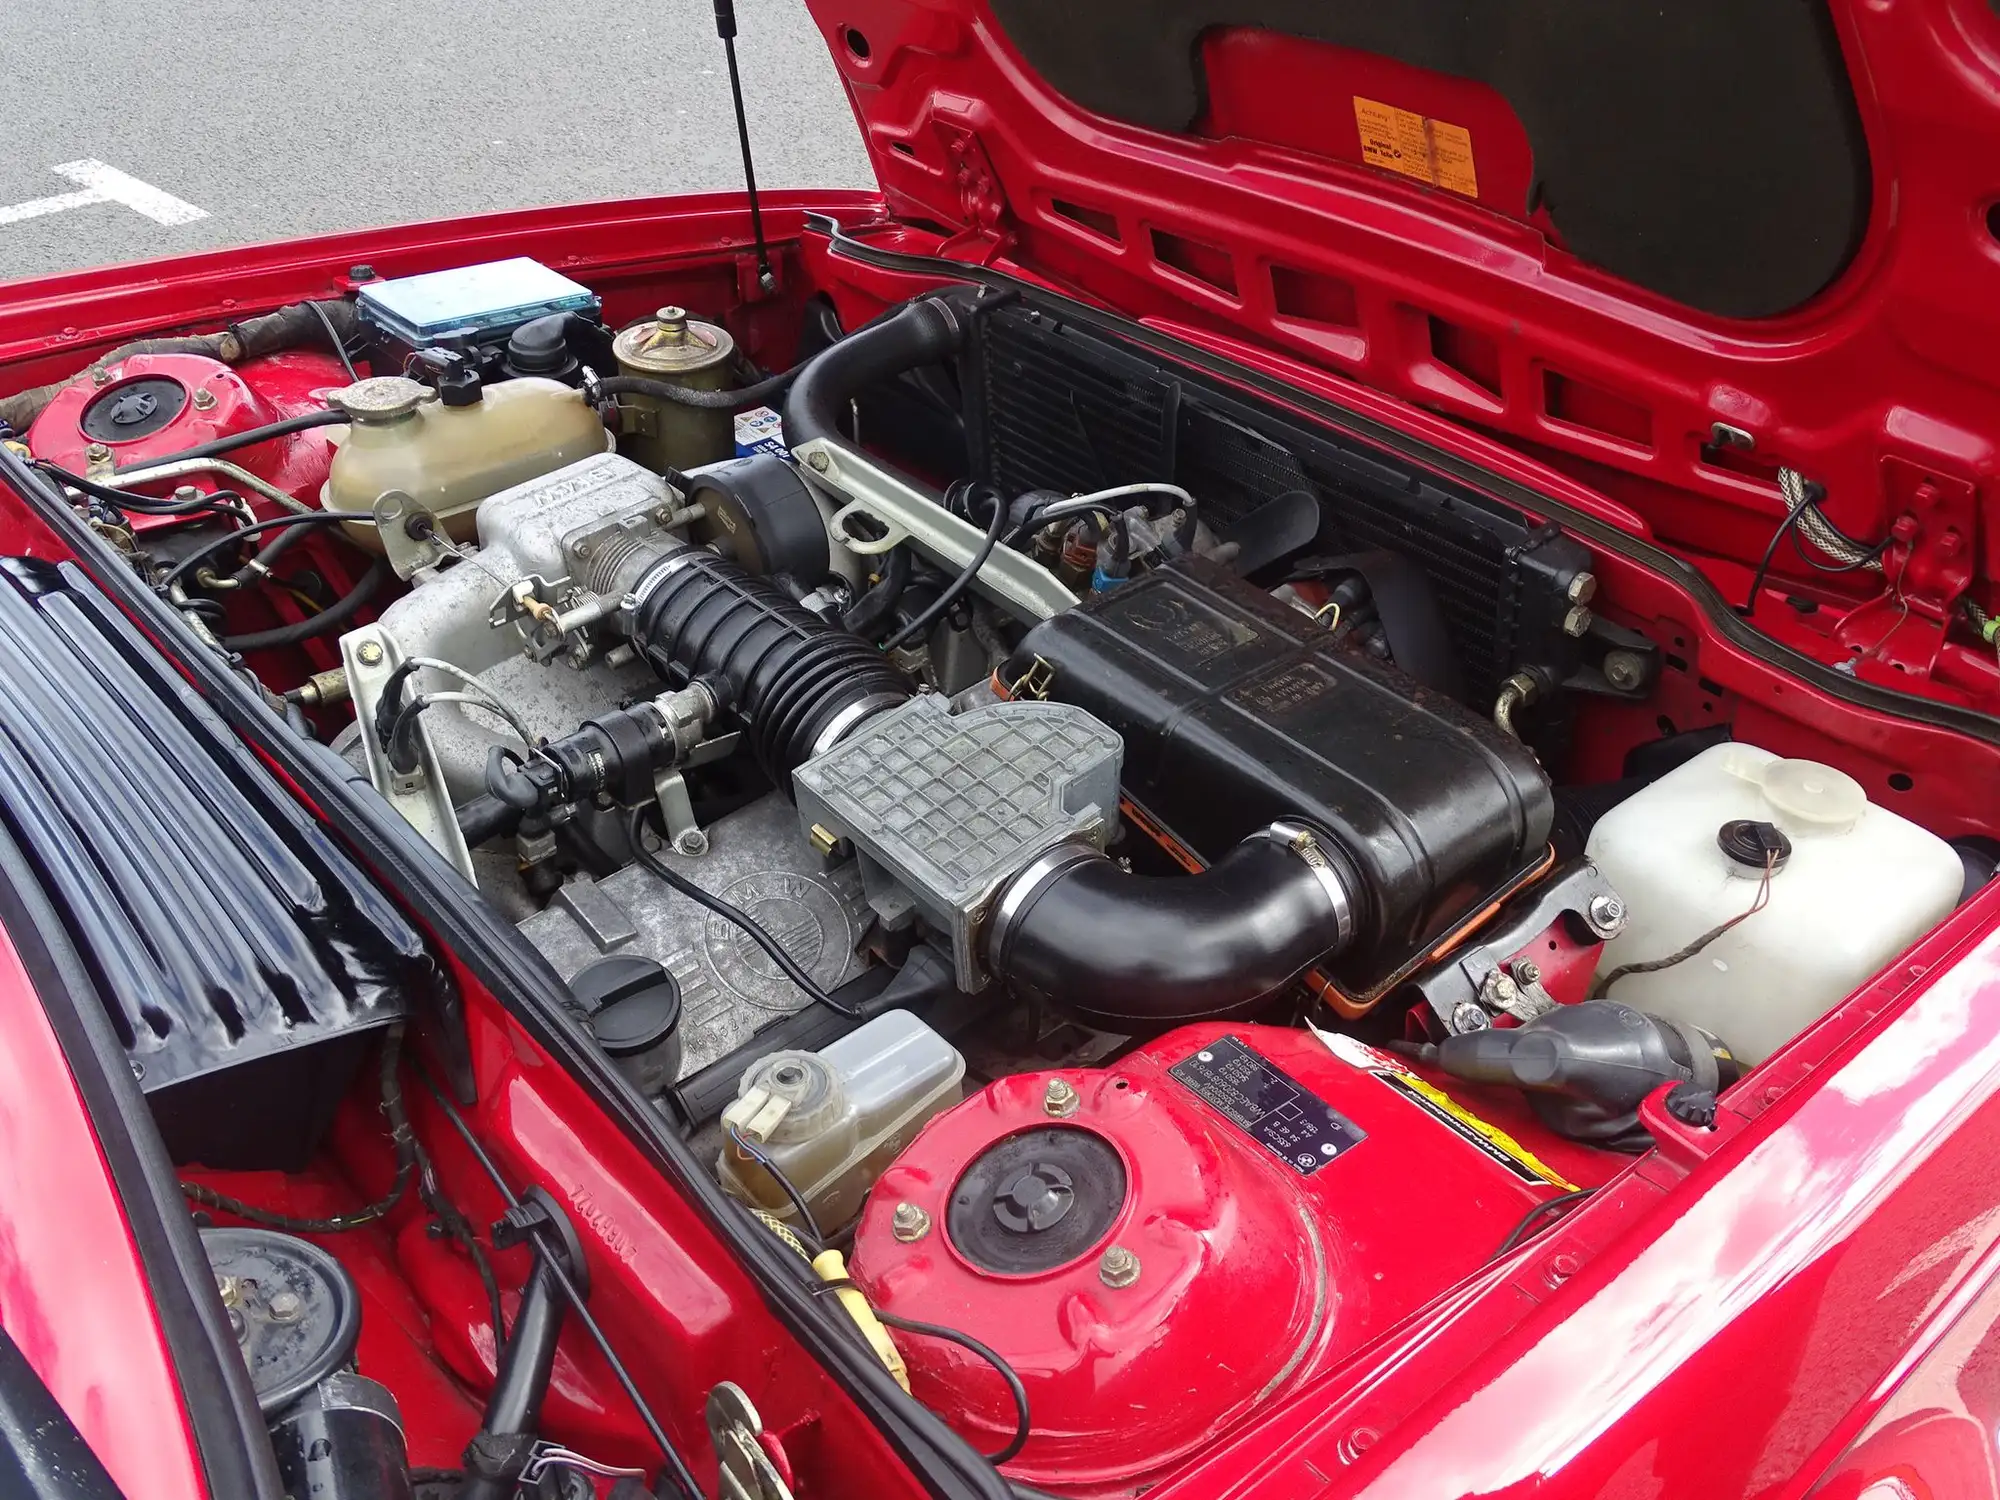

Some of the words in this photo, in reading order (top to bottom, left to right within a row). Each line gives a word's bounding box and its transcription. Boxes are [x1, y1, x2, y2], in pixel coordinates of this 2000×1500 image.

[1363, 145, 1378, 155] BMW
[1370, 139, 1392, 149] Original
[709, 877, 812, 941] BMW
[1174, 1068, 1186, 1076] AG
[1183, 1074, 1202, 1088] WERKE
[1199, 1086, 1225, 1105] MOTOREN
[1222, 1104, 1252, 1126] BAYERISCHE
